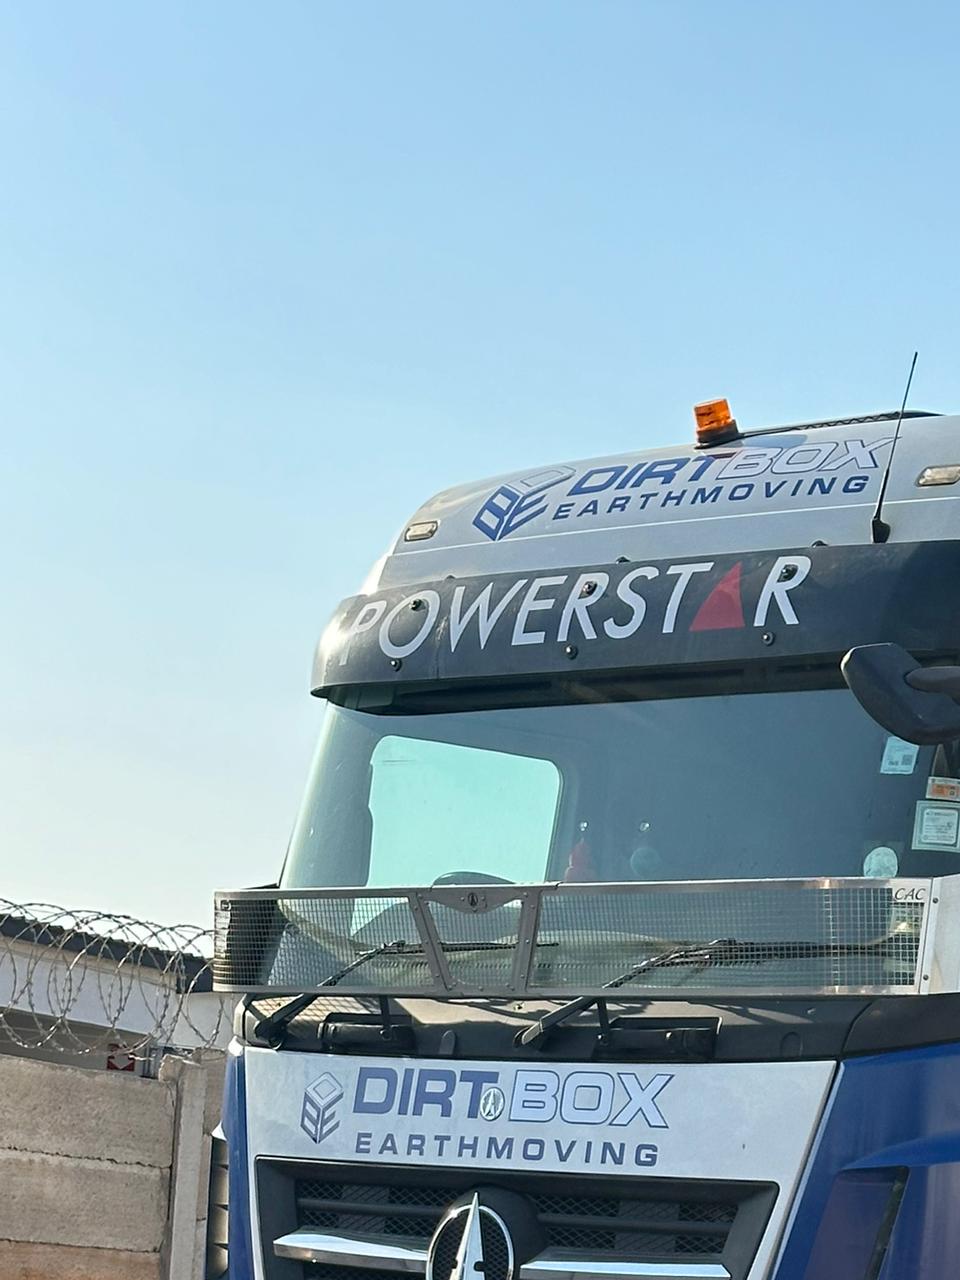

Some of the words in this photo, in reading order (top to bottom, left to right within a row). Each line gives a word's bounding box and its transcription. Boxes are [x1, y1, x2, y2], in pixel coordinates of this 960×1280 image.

[567, 436, 898, 496] DIRTBOX
[552, 474, 870, 521] EARTHMOVING
[338, 555, 812, 666] POWERSTAR
[894, 887, 926, 901] CAC
[355, 1132, 659, 1167] EARTHMOVING
